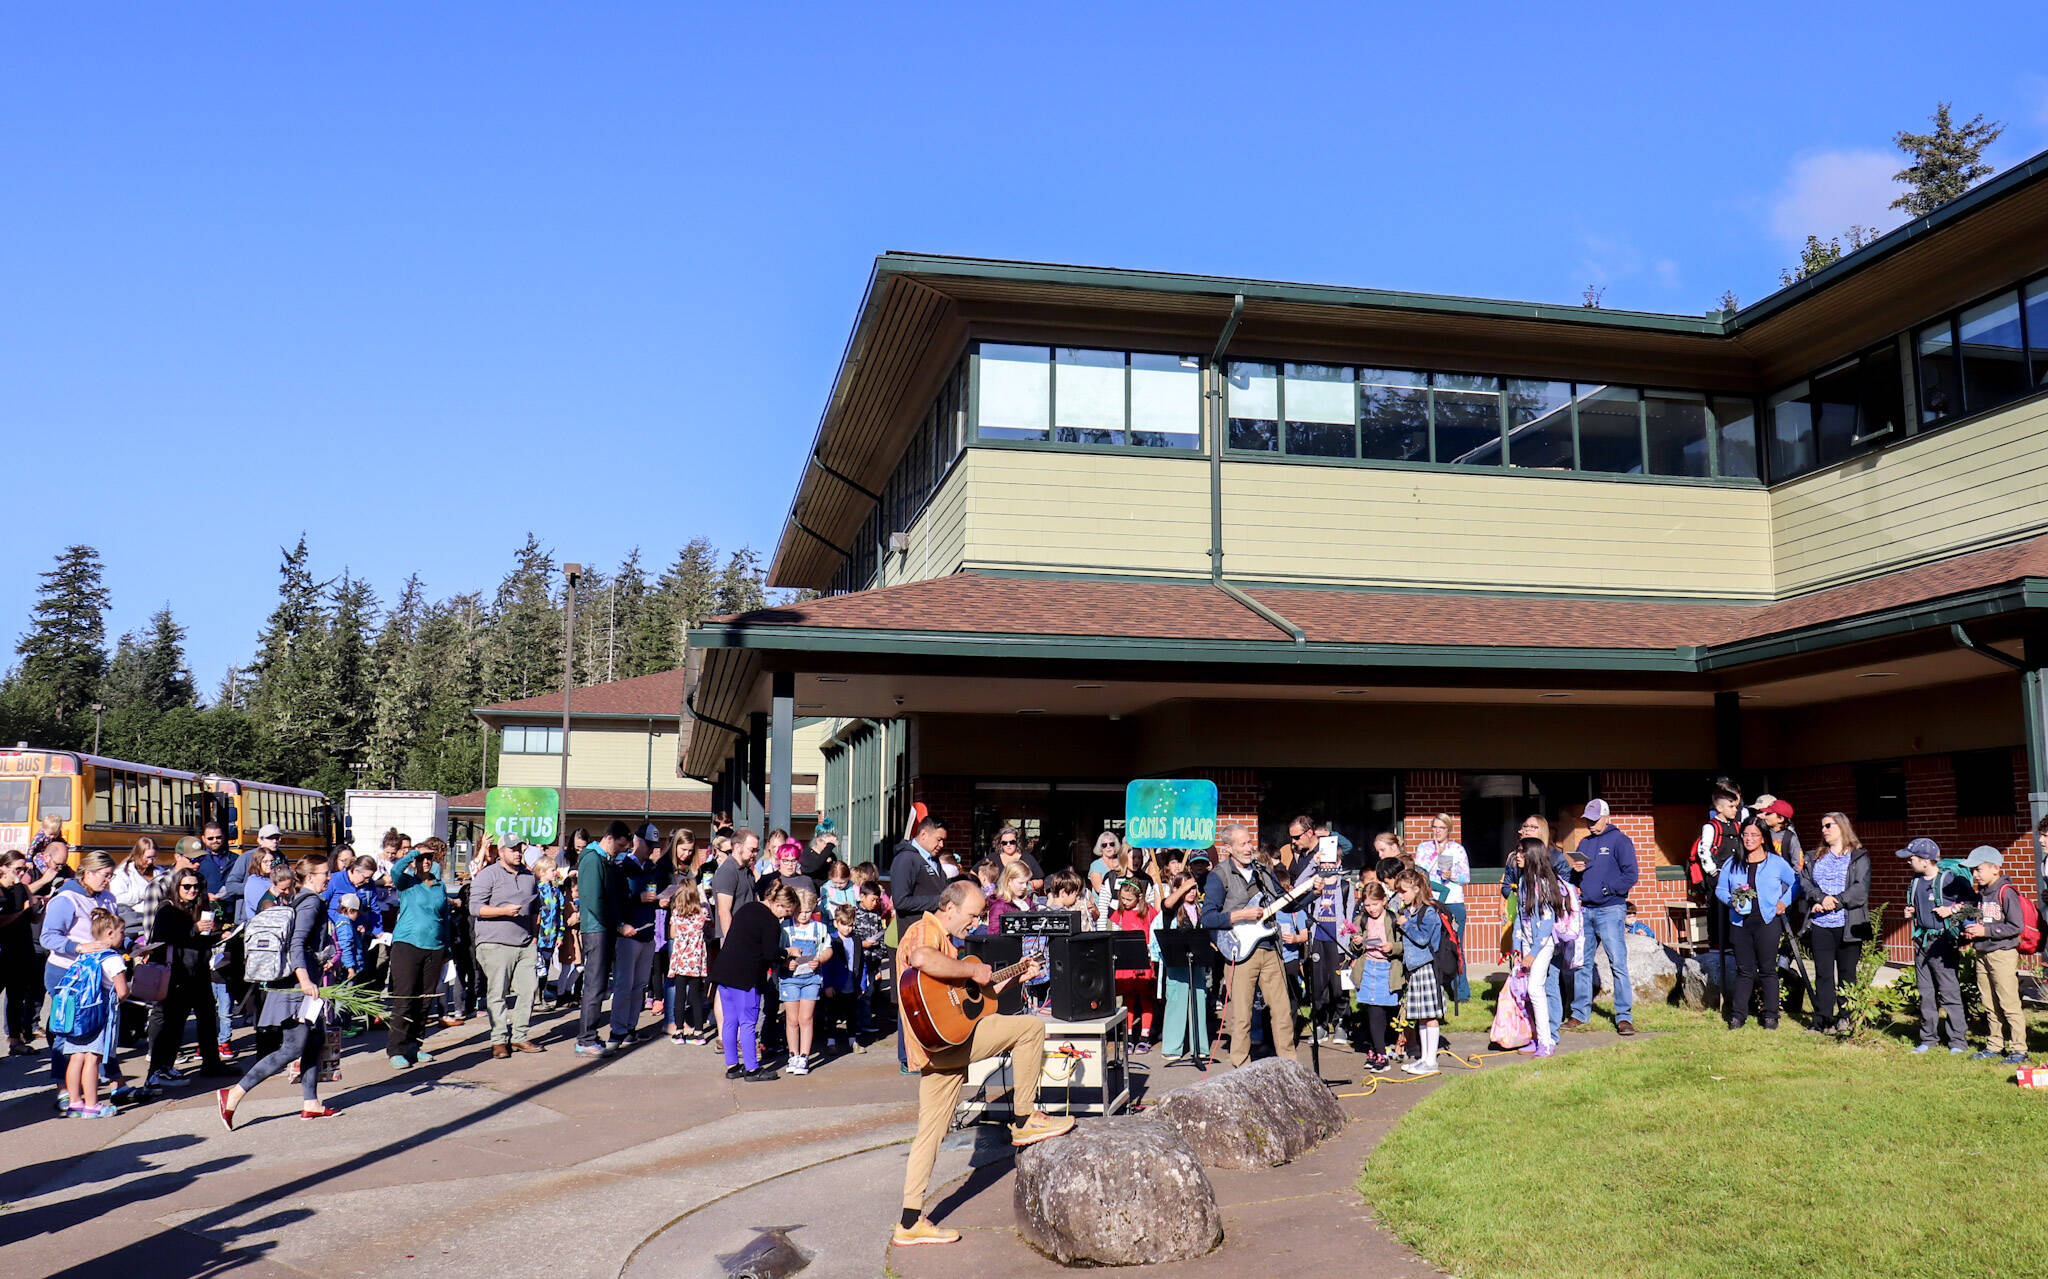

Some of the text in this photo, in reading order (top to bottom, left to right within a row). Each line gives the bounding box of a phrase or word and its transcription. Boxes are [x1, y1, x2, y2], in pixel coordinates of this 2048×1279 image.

[16, 757, 40, 772] BUS
[496, 816, 553, 837] CETUS
[1129, 816, 1214, 842] CANIS MAJOR
